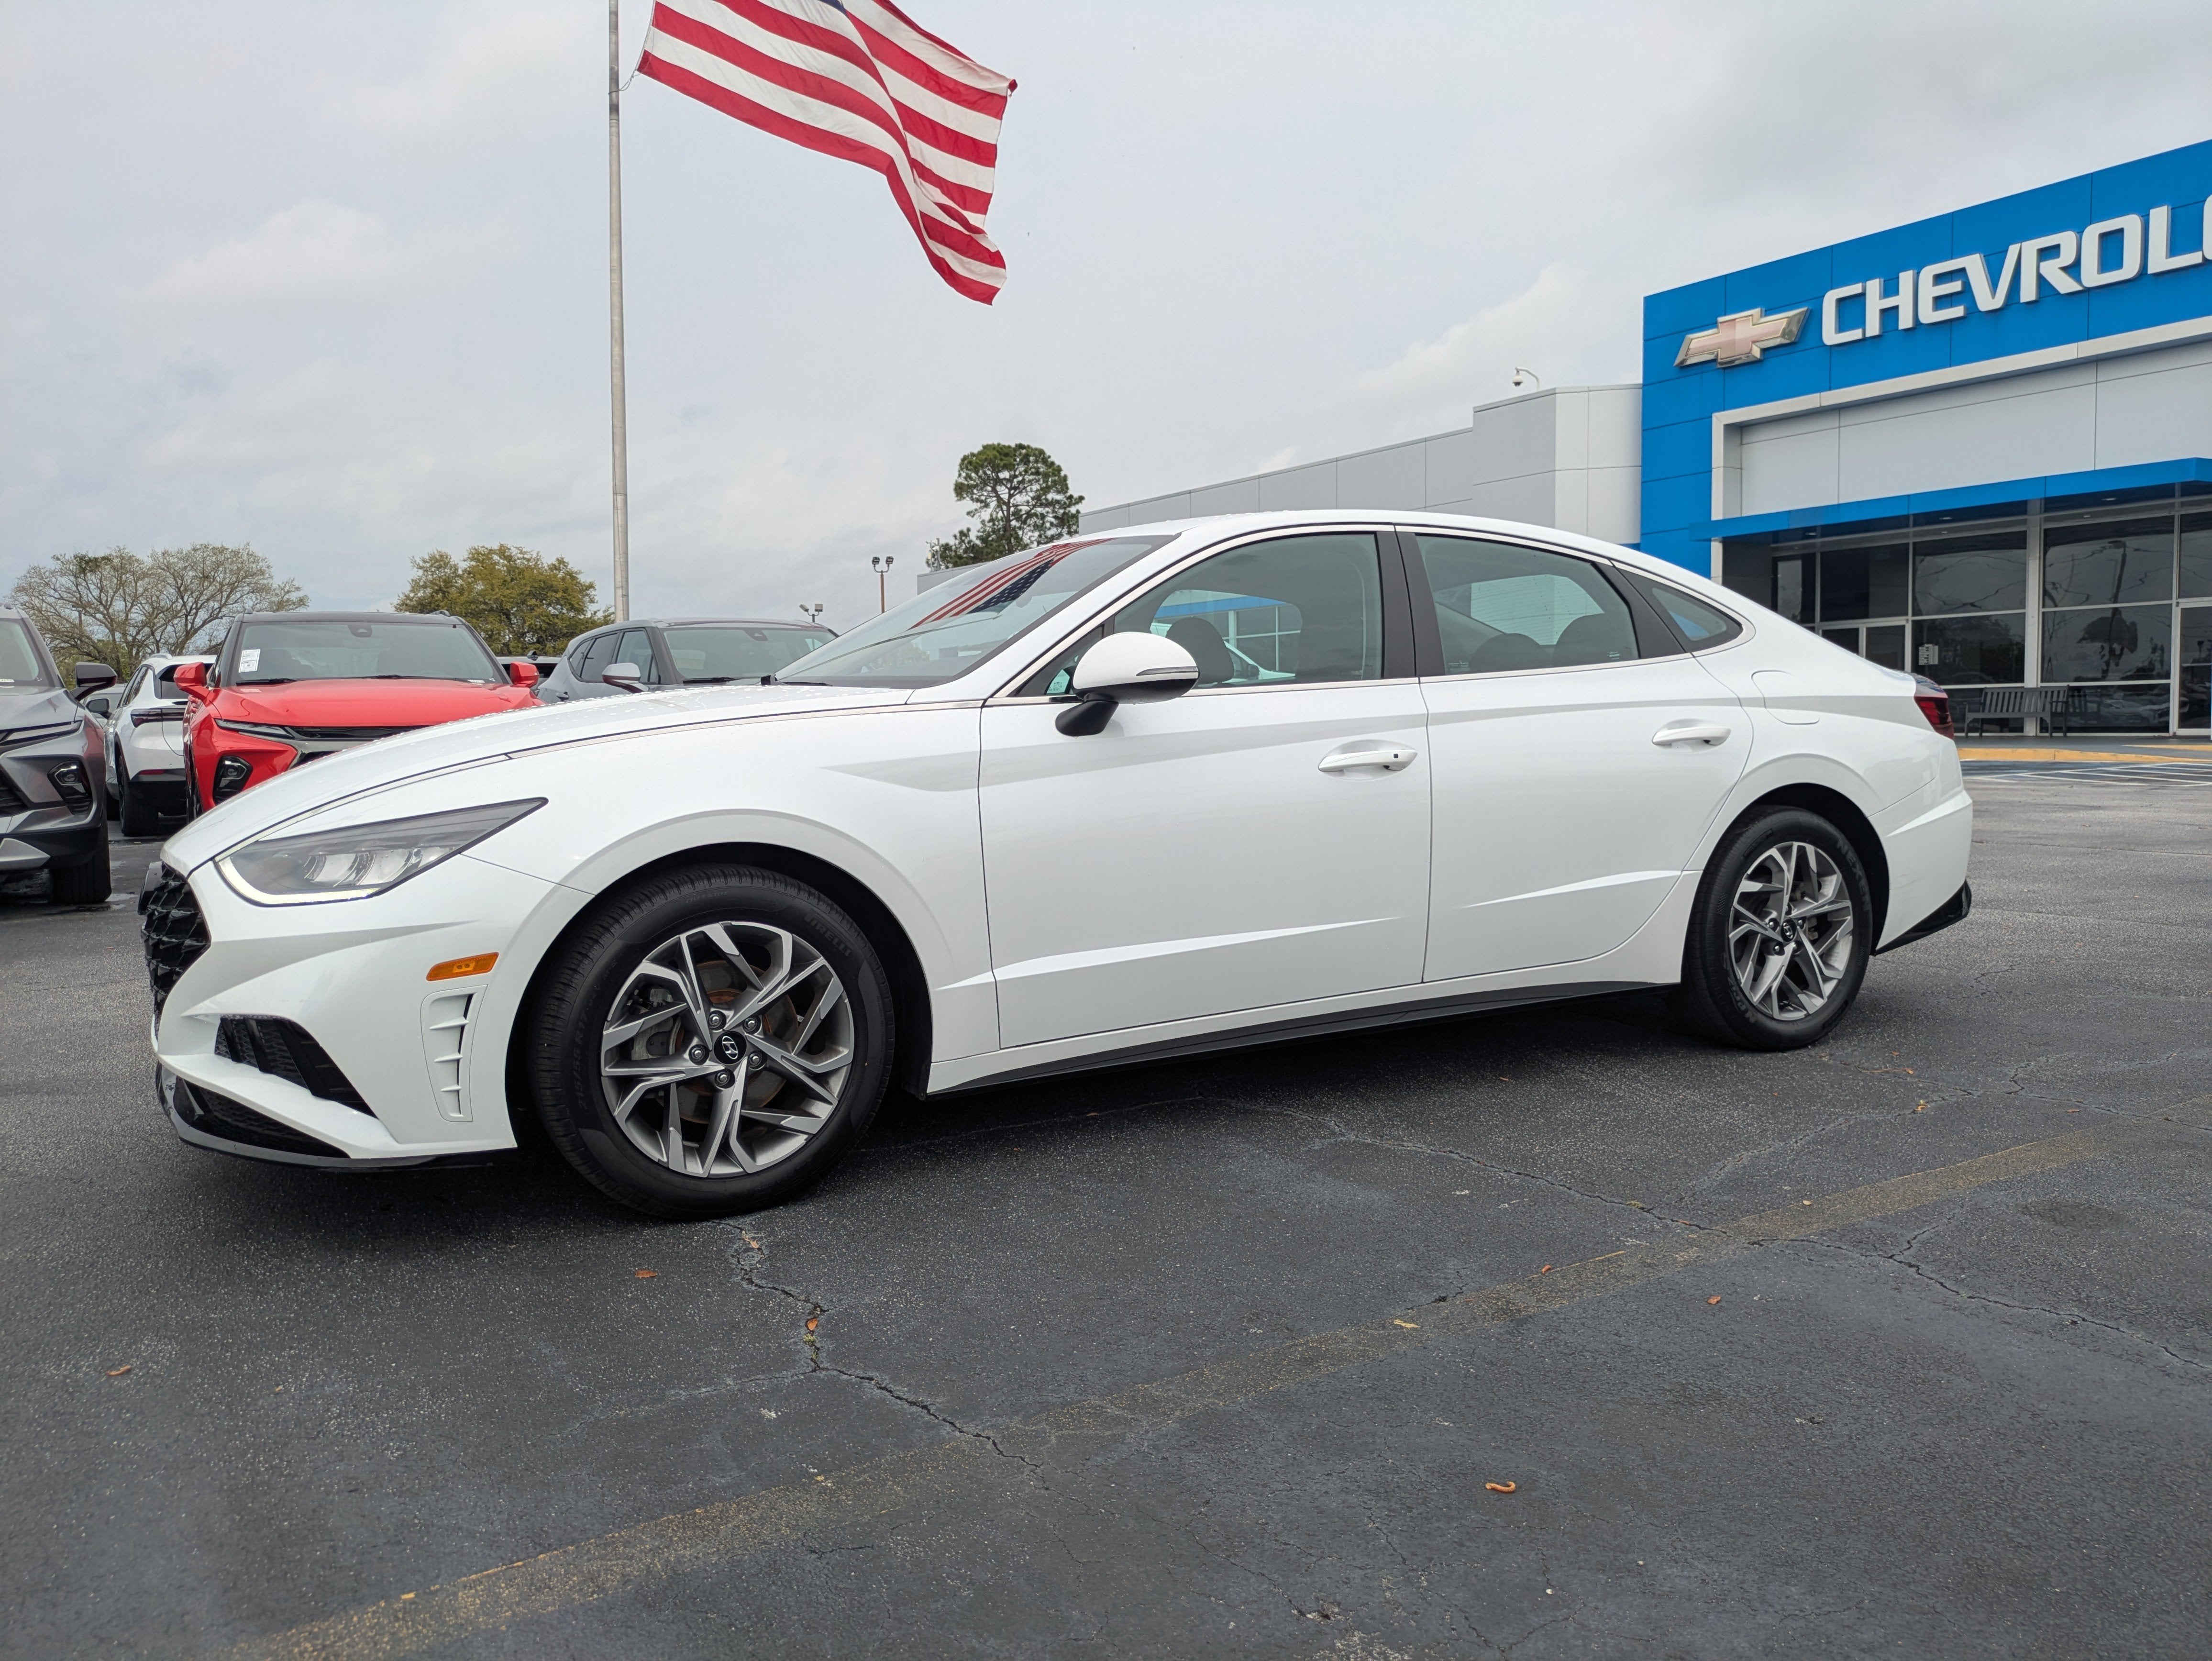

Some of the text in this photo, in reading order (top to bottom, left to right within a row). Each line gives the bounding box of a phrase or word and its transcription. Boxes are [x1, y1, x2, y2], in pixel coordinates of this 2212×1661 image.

[1822, 194, 2212, 345] CHEVROL
[686, 891, 729, 904] OUTSIDE
[1836, 839, 1871, 911] NEXEN
[804, 908, 853, 957] PIRELLI
